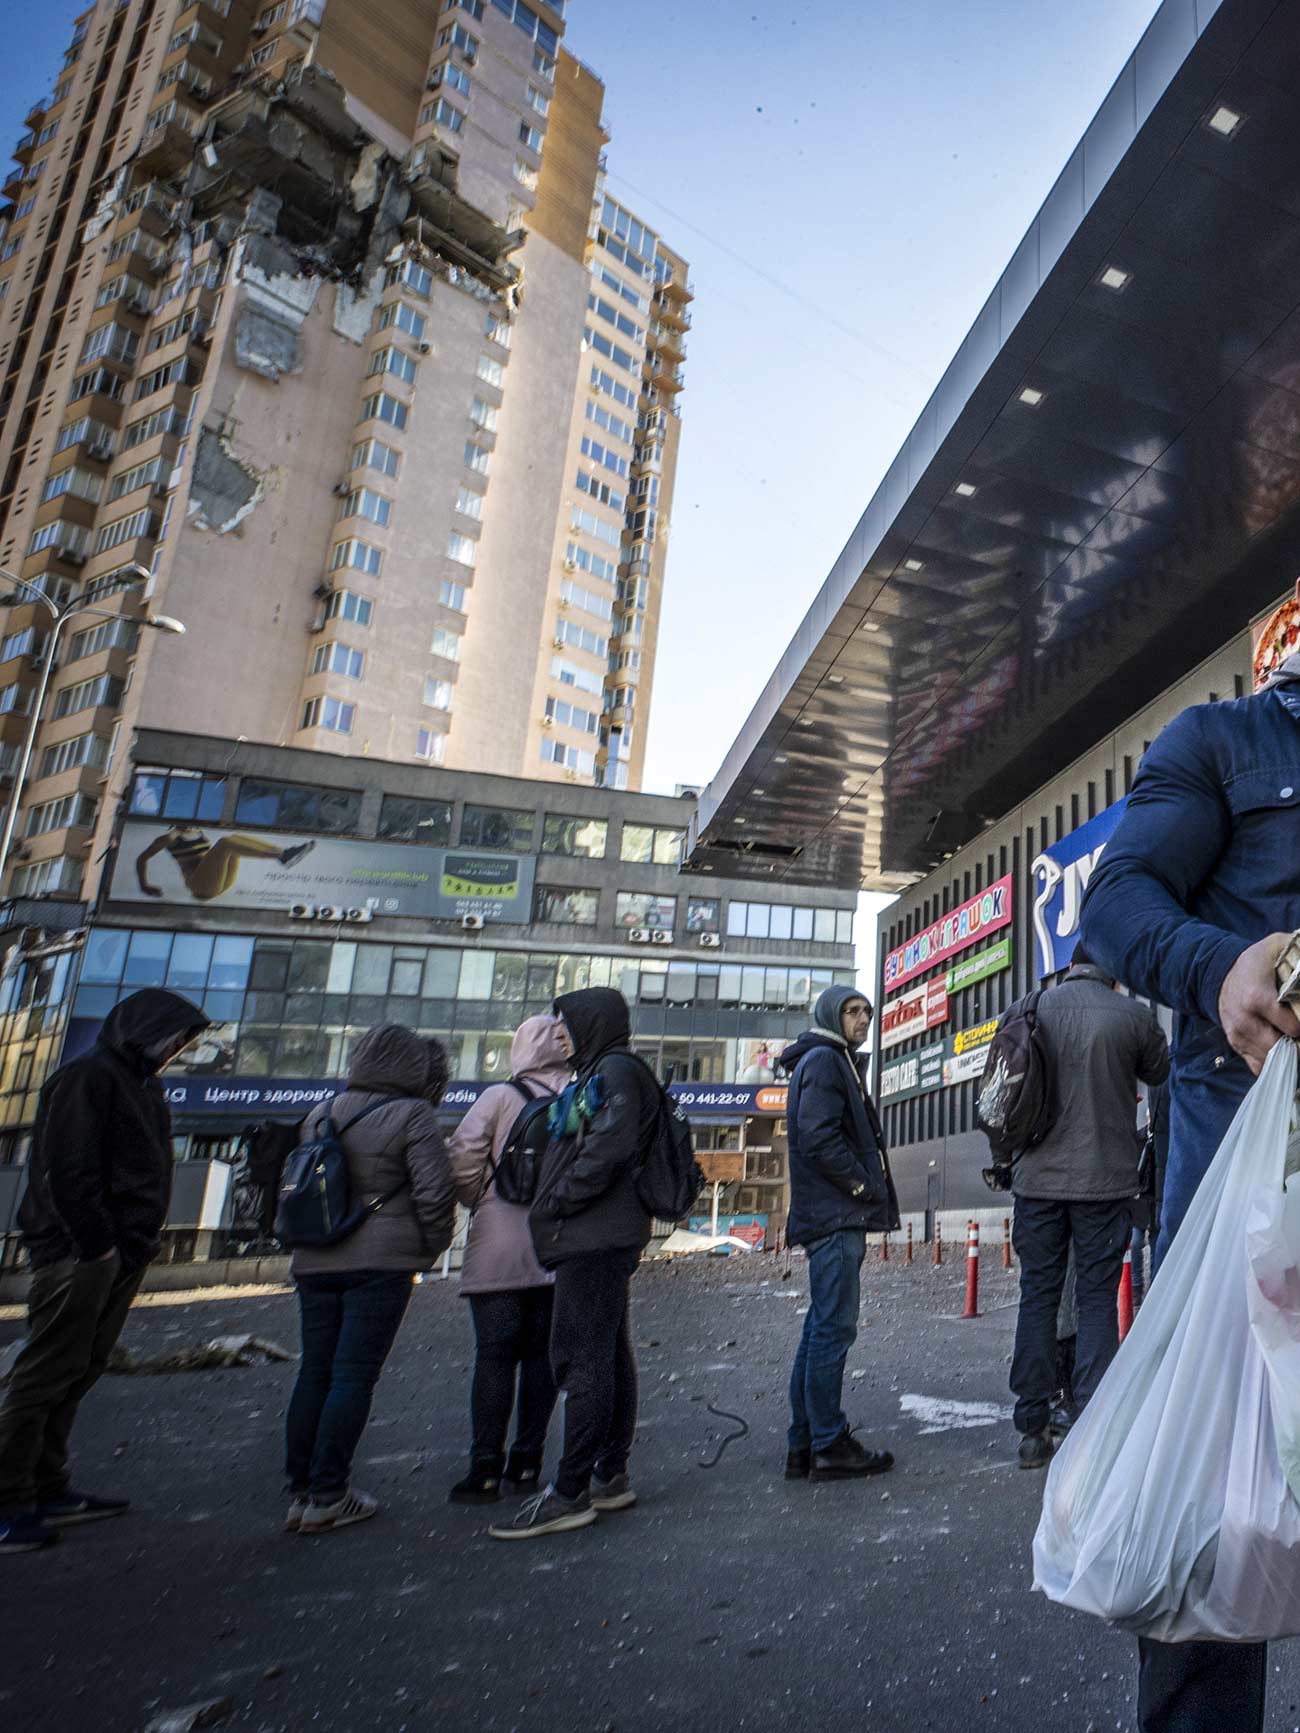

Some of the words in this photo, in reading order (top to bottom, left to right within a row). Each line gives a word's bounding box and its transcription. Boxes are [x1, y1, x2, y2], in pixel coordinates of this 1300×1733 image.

[884, 926, 942, 986] БУДИНОК
[939, 886, 1006, 951] ІГРАШОК
[205, 1087, 260, 1104] Центр
[443, 1089, 478, 1103] обів
